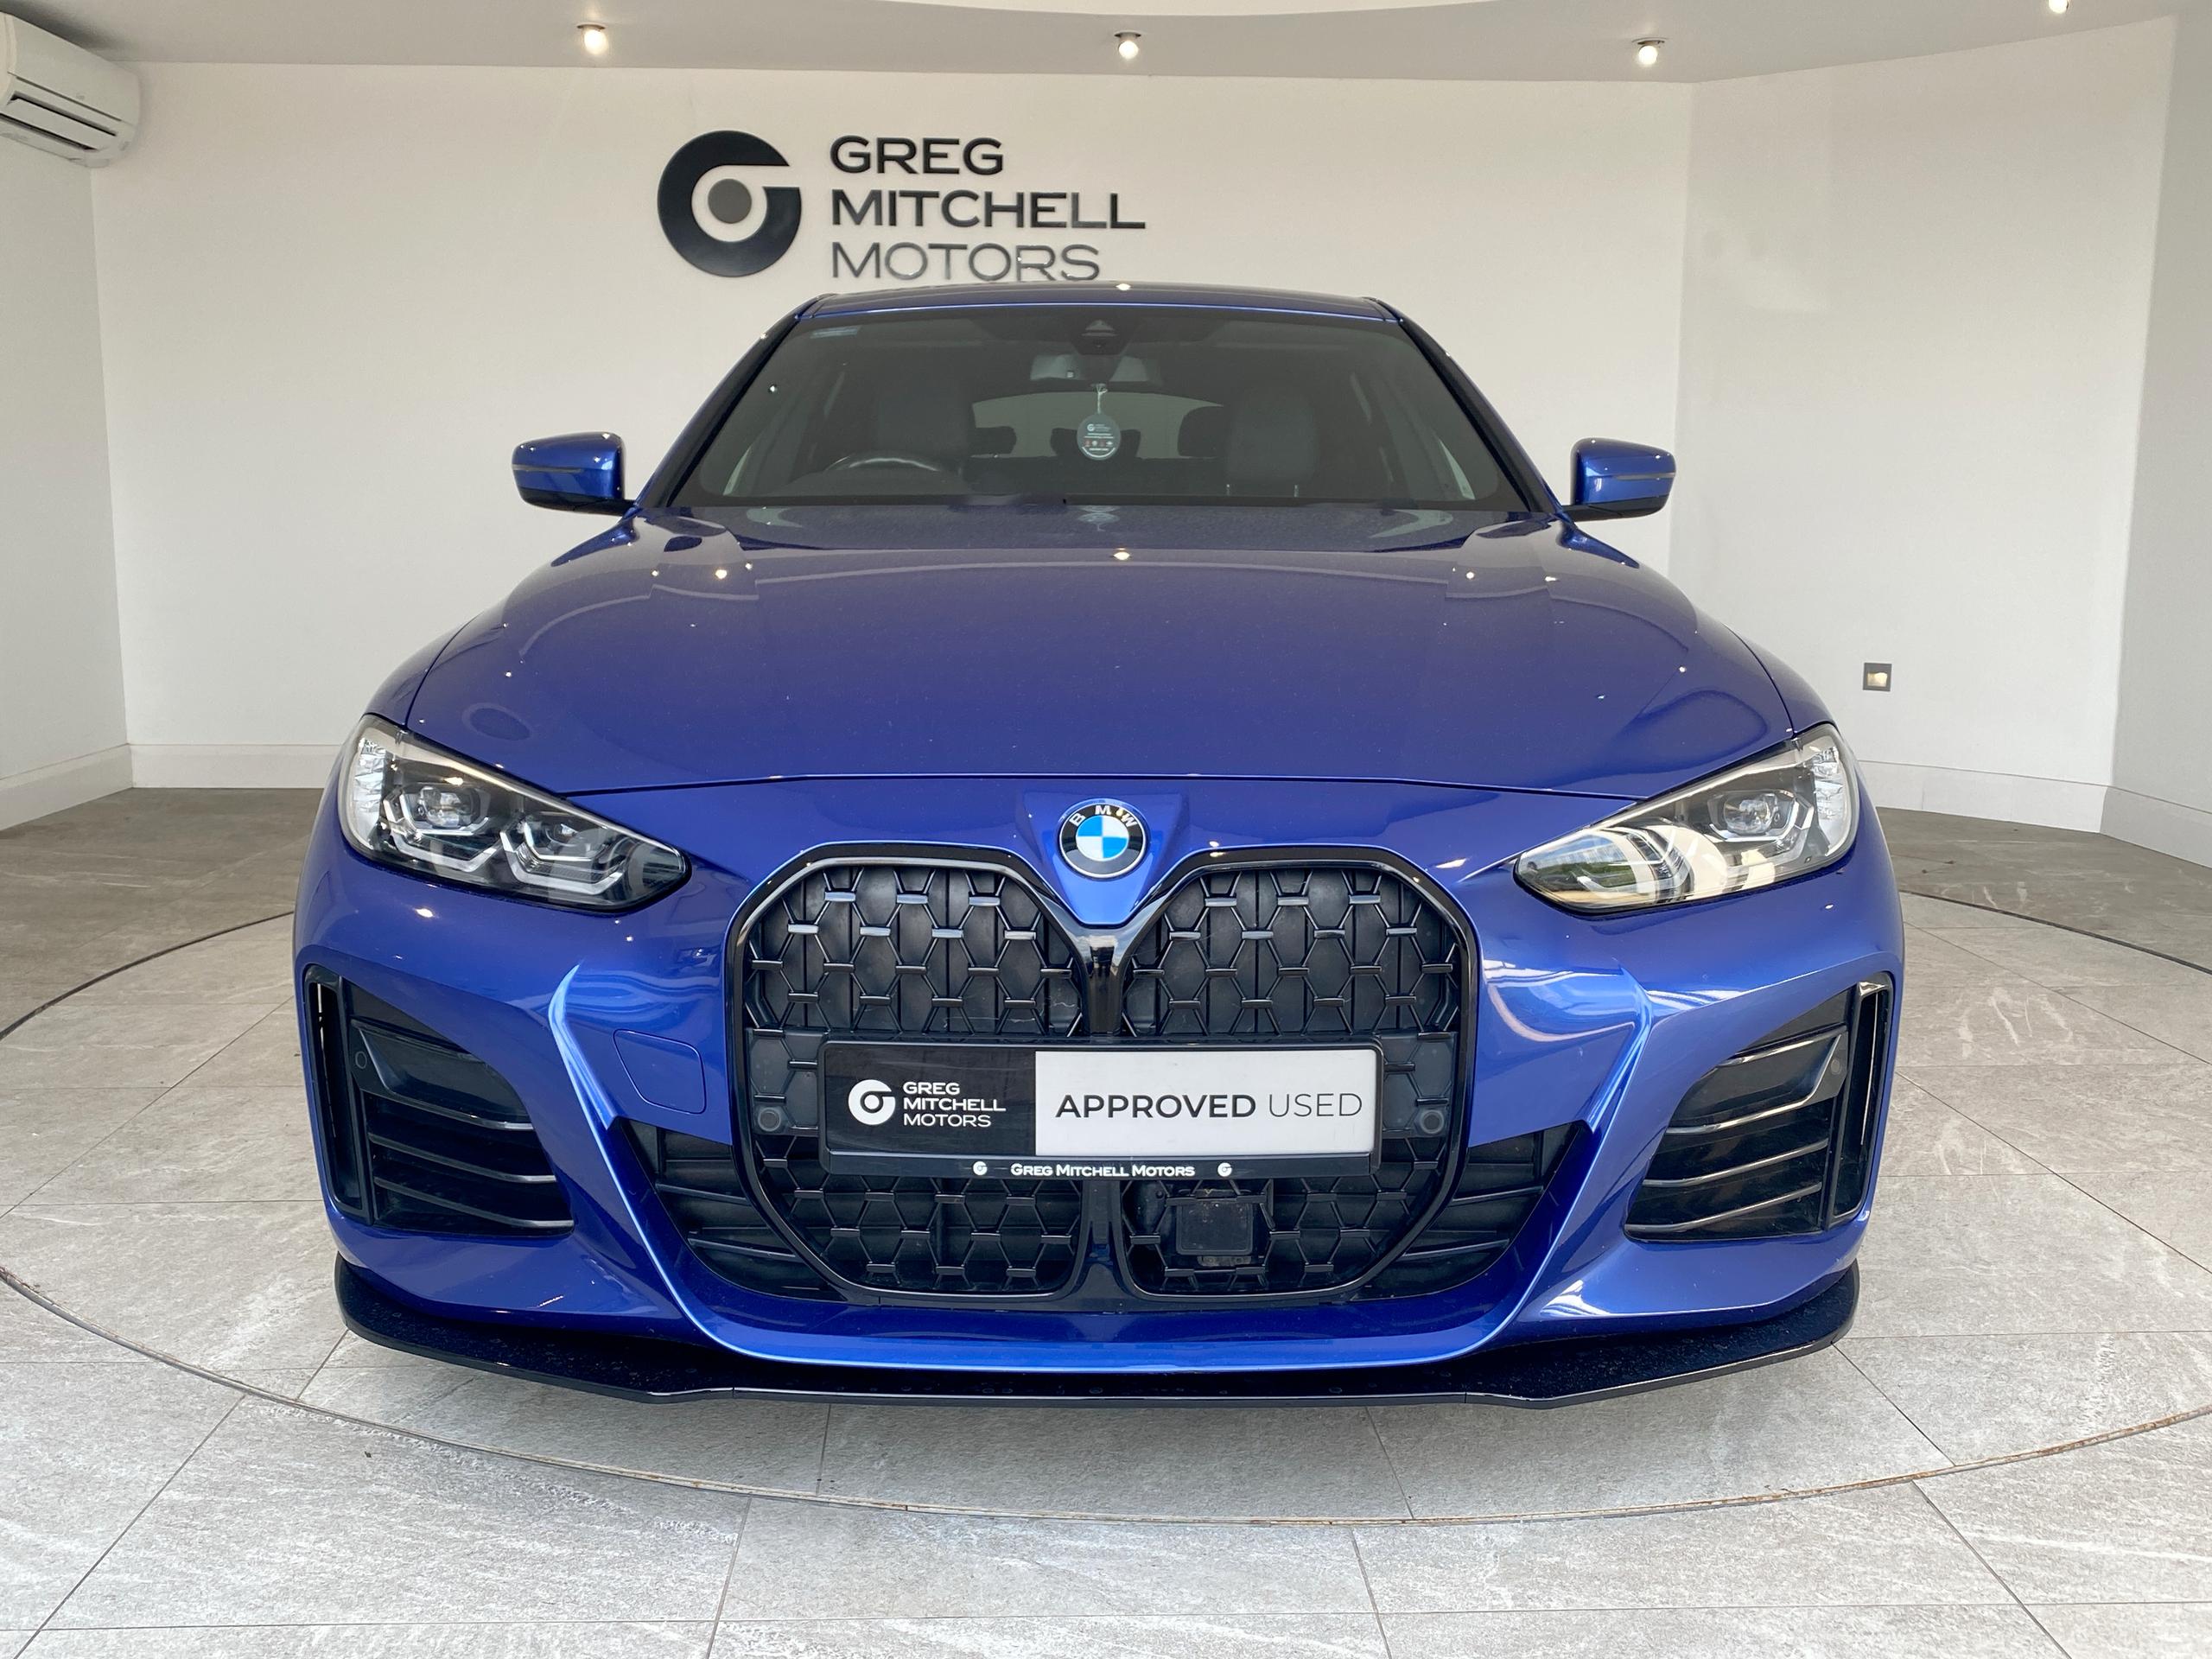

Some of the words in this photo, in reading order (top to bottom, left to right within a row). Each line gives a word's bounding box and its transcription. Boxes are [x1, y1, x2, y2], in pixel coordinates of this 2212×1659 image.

[830, 135, 1003, 175] GREG
[831, 189, 1146, 229] MITCHELL
[831, 241, 1100, 281] MOTORS
[1069, 804, 1138, 827] BMW
[903, 1082, 960, 1096] GREG
[903, 1097, 1007, 1112] MITCHELL
[1055, 1094, 1256, 1119] APPROVED
[1268, 1092, 1363, 1118] USED
[903, 1114, 991, 1128] MOTORS
